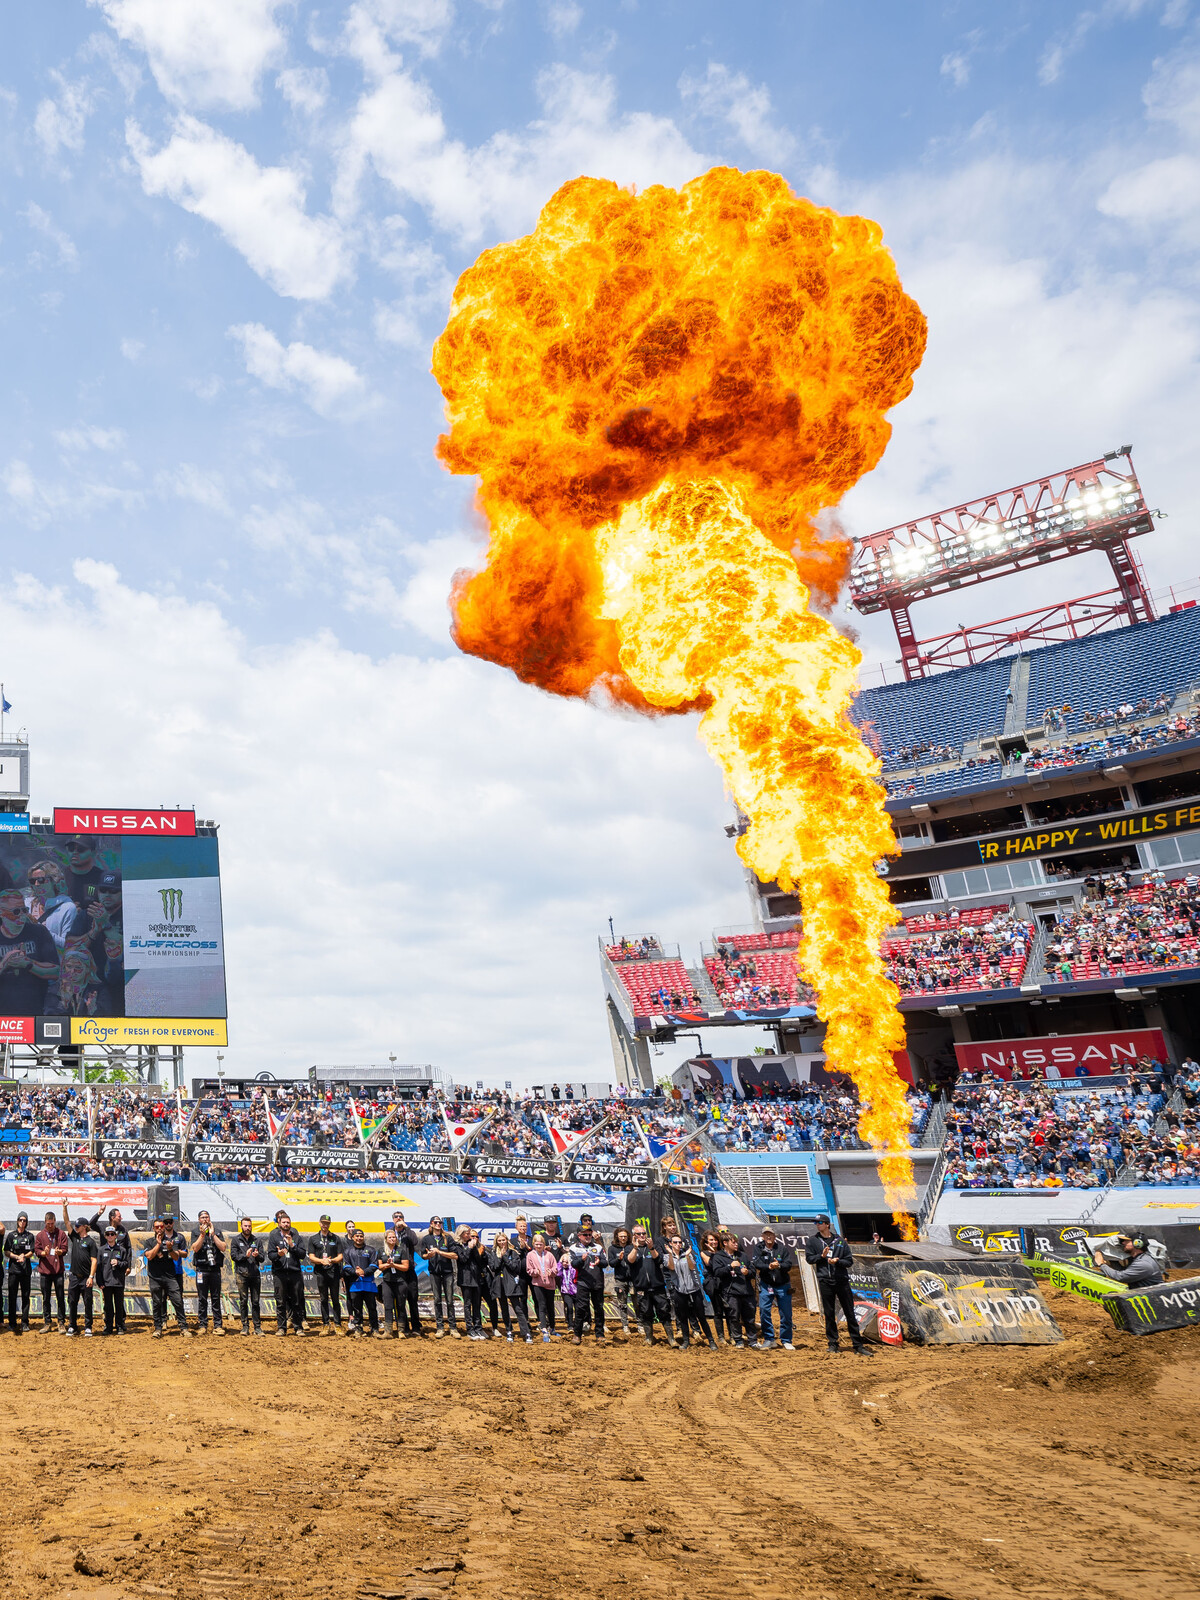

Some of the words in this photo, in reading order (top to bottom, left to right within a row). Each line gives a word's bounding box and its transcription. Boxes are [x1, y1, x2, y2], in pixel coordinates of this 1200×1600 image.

[73, 815, 177, 829] NISSAN
[1005, 828, 1080, 855] HAPPY
[1099, 813, 1169, 840] WILLS
[128, 940, 218, 949] SUPERCROSS
[79, 1019, 118, 1042] Kroger
[123, 1028, 150, 1036] FRESH
[152, 1028, 169, 1036] FOR
[172, 1028, 214, 1037] EVERYONE
[981, 1042, 1138, 1067] NISSAN
[229, 1146, 267, 1154] MOUNTAIN
[296, 1149, 321, 1157] ROCKY
[322, 1150, 360, 1159] MOUNTAIN
[388, 1153, 411, 1161] ROCKY
[487, 1157, 511, 1165] ROCKY
[511, 1159, 549, 1168] MOUNTAIN
[585, 1164, 609, 1172] ROCKY
[609, 1166, 648, 1175] MOUNTAIN
